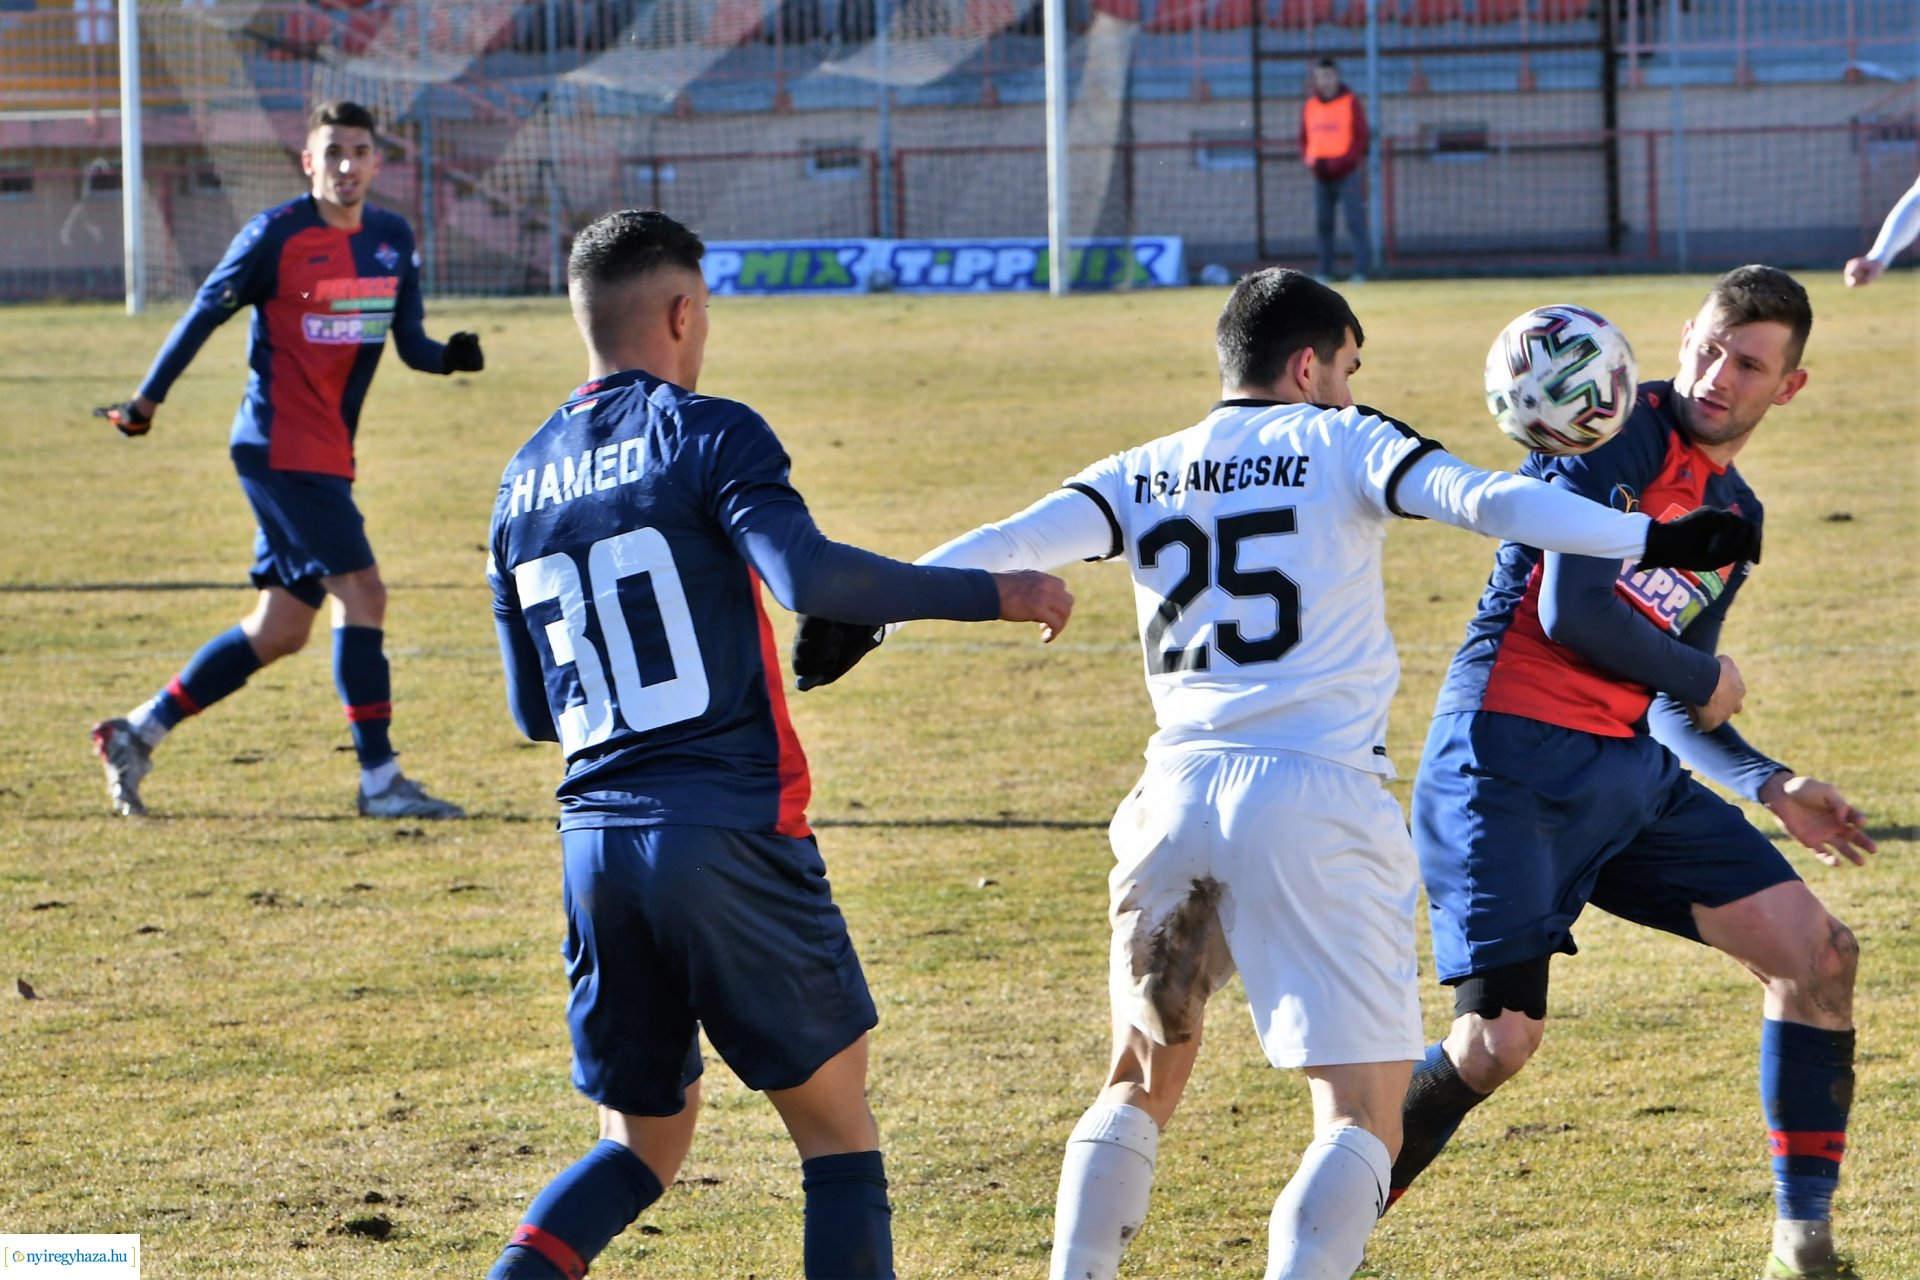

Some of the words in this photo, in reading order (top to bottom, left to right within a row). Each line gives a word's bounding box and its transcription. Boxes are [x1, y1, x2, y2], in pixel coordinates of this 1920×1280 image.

[510, 437, 645, 518] HAMED
[514, 526, 710, 763] 30
[1137, 505, 1302, 676] 25
